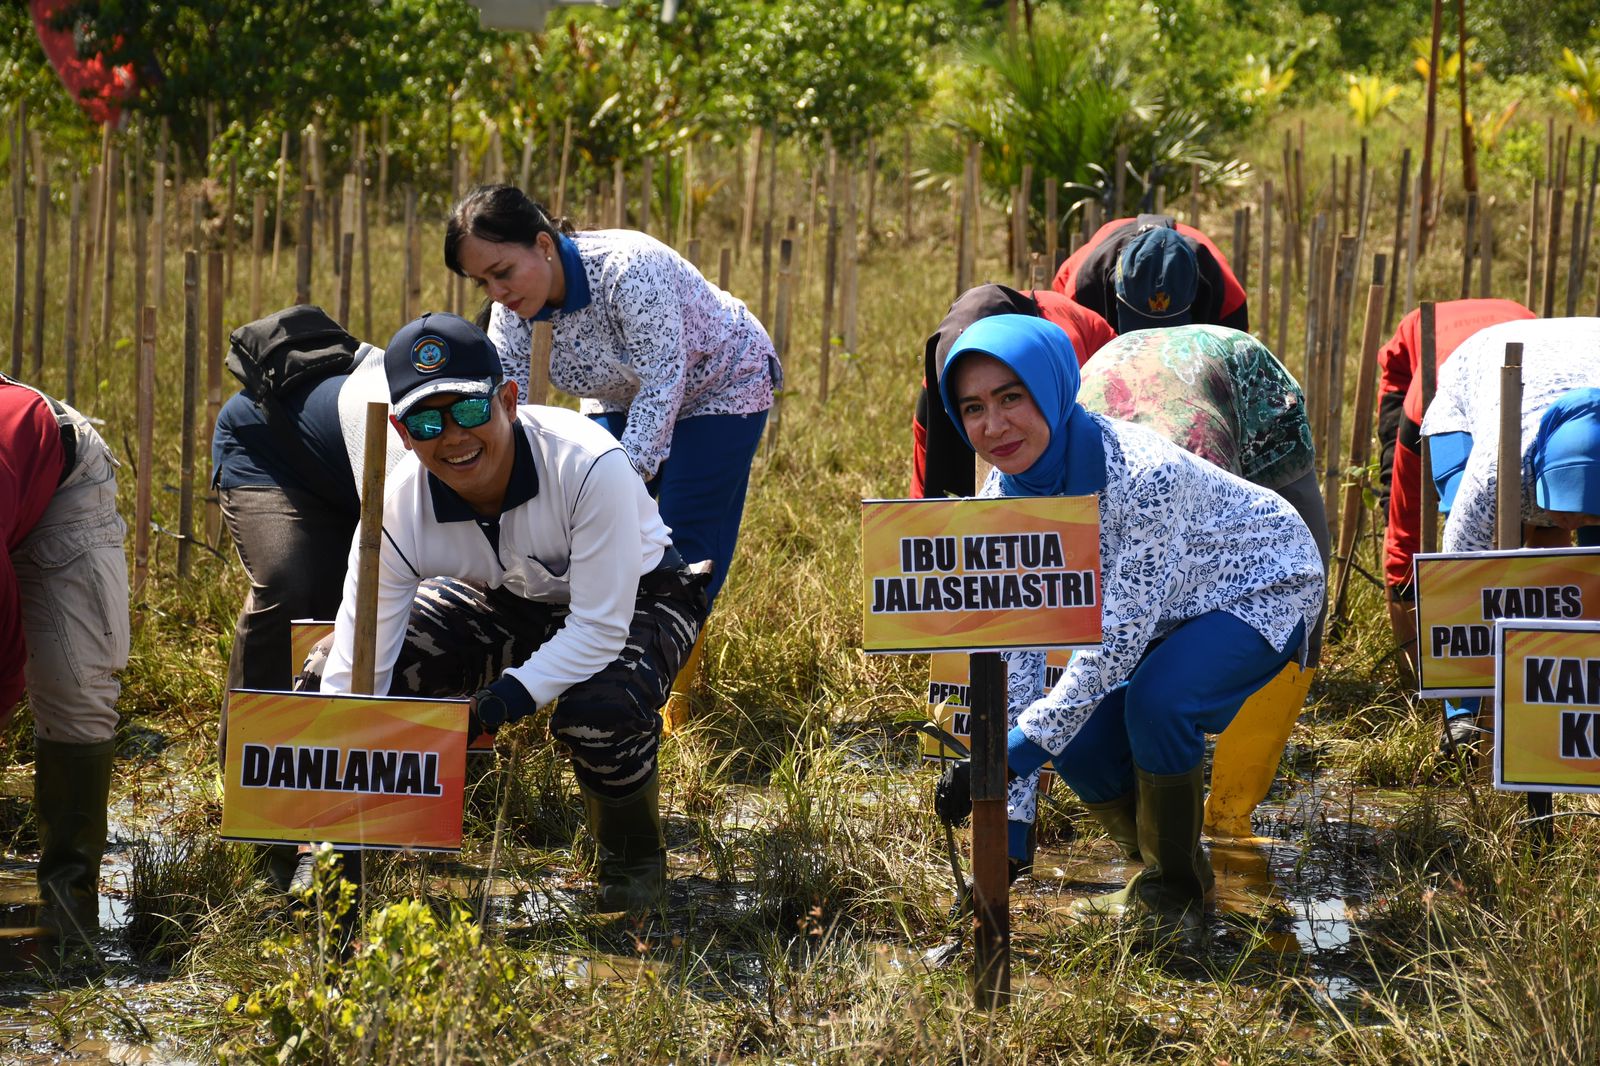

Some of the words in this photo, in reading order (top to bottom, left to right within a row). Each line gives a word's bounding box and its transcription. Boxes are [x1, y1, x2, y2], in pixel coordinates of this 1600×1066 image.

[900, 535, 957, 574] IBU
[961, 532, 1065, 572] KETUA
[871, 570, 1096, 614] JALASENASTRI
[1481, 585, 1583, 620] KADES
[1560, 711, 1600, 760] K
[241, 743, 443, 797] DANLANAL
